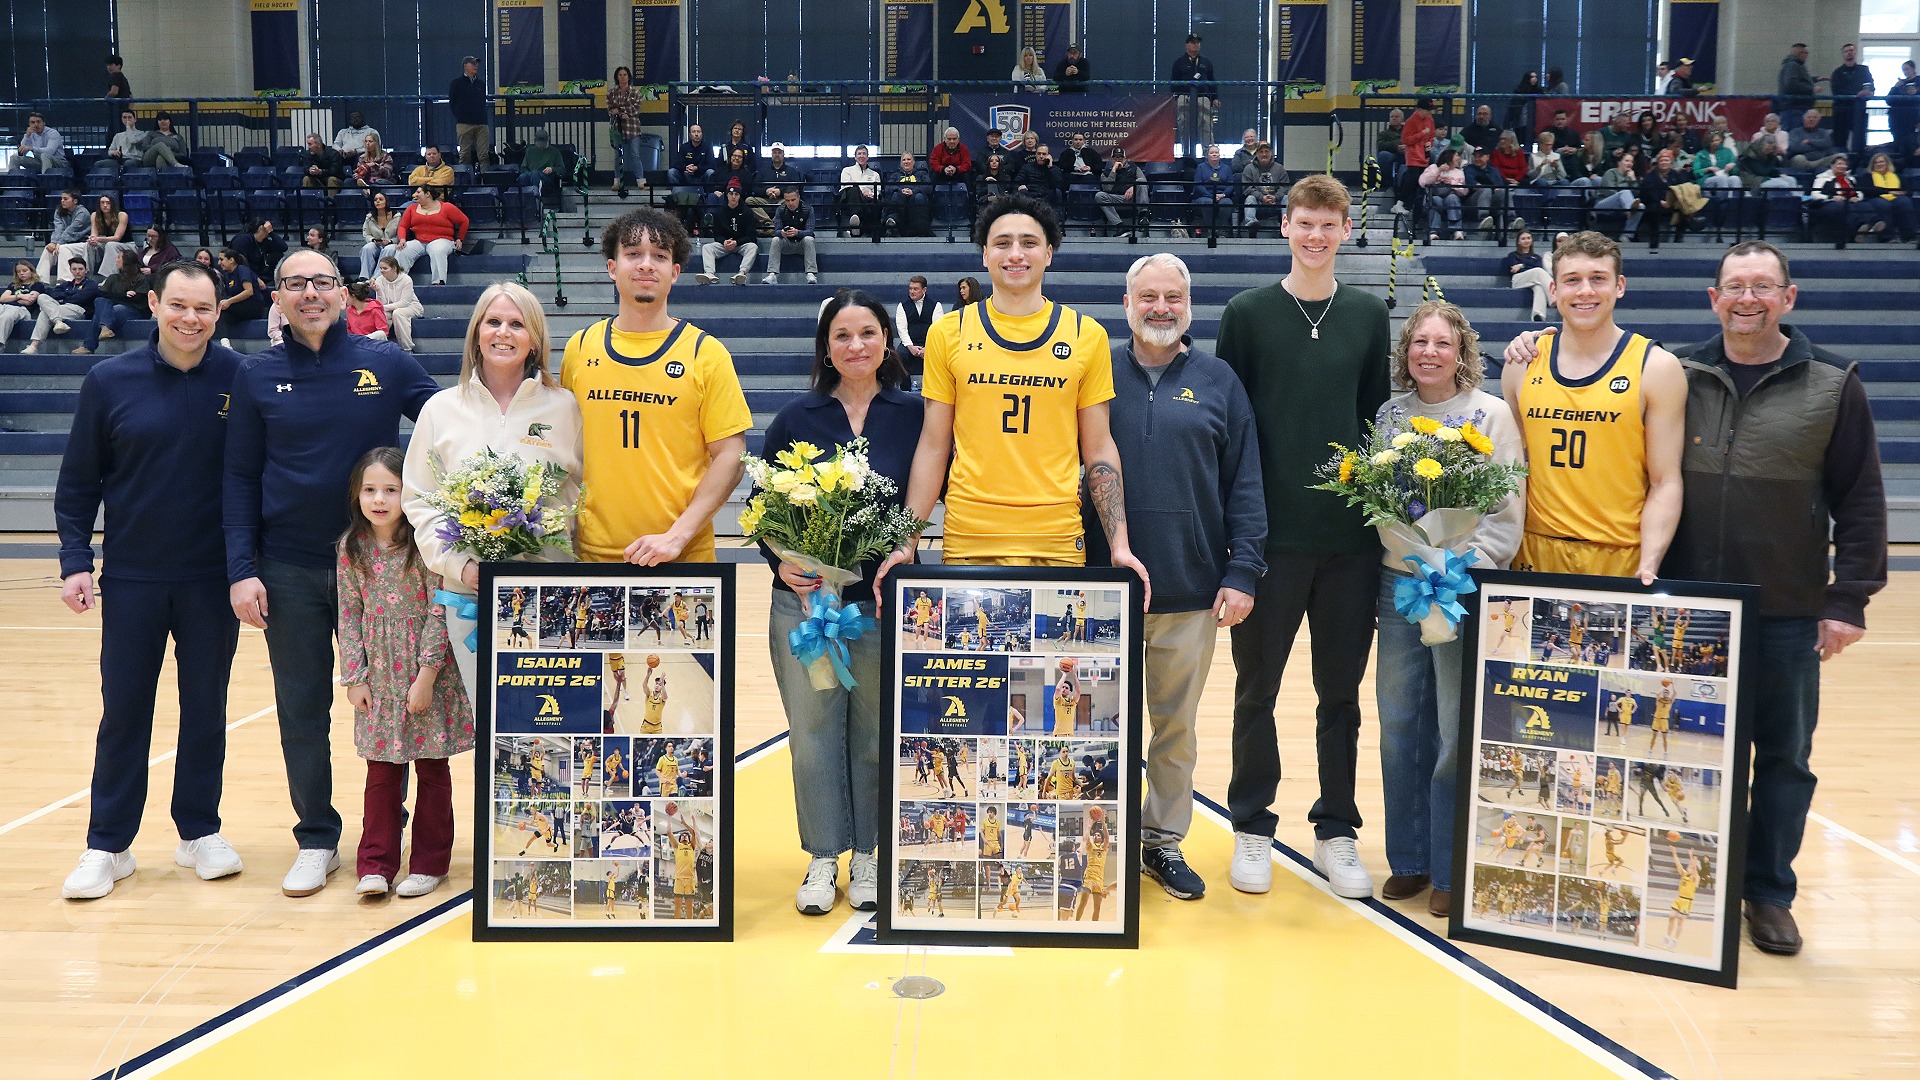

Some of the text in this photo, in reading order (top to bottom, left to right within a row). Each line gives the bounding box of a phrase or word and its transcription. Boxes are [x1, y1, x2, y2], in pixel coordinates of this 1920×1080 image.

[1049, 110, 1135, 118] CELEBRATING THE PAST.
[998, 115, 1022, 134] 50
[1053, 345, 1070, 356] GB
[666, 363, 684, 375] GB
[966, 373, 1068, 389] ALLEGHENY
[1610, 379, 1629, 390] GB
[586, 389, 678, 406] ALLEGHENY
[1002, 393, 1031, 434] 21
[1526, 407, 1622, 423] ALLEGHENY
[619, 409, 640, 449] 11
[1550, 427, 1587, 469] 20
[516, 657, 583, 669] ISAIAH
[923, 658, 988, 671] JAMES
[497, 675, 602, 687] PORTIS 26'
[904, 675, 1008, 689] SITTER 26'
[1511, 667, 1570, 683] RYAN
[1493, 683, 1588, 703] LANG 26'
[1064, 857, 1076, 869] 12
